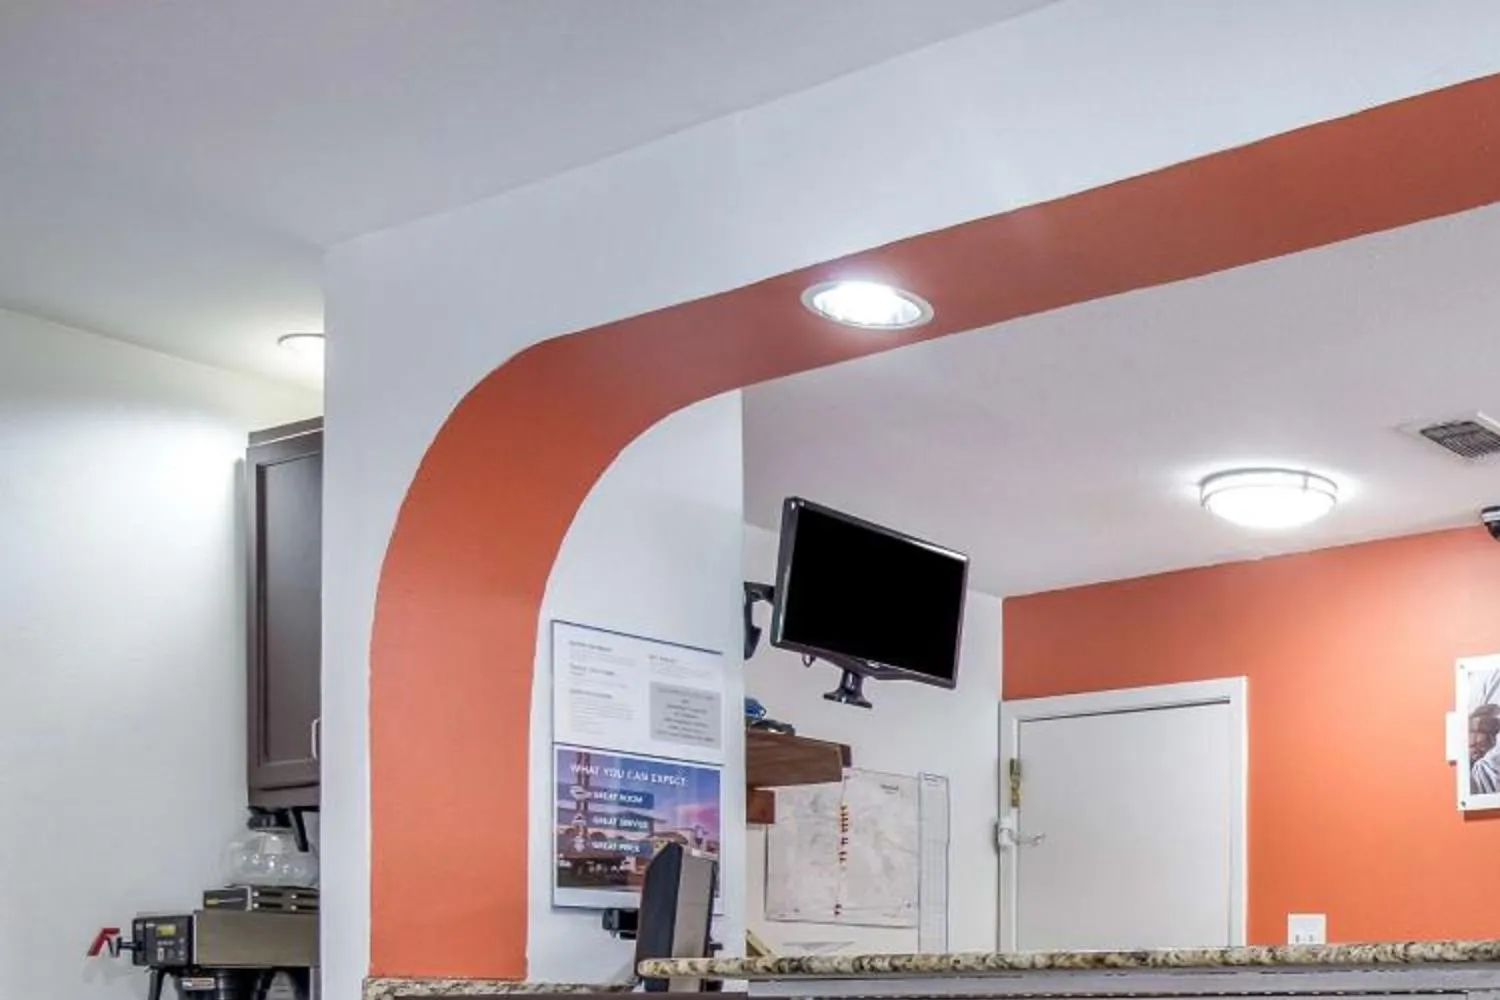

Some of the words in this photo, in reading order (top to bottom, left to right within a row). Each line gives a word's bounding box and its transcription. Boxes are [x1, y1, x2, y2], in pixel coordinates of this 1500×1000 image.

[570, 764, 600, 775] WHAT
[603, 768, 625, 779] YOU
[627, 771, 648, 782] CAN
